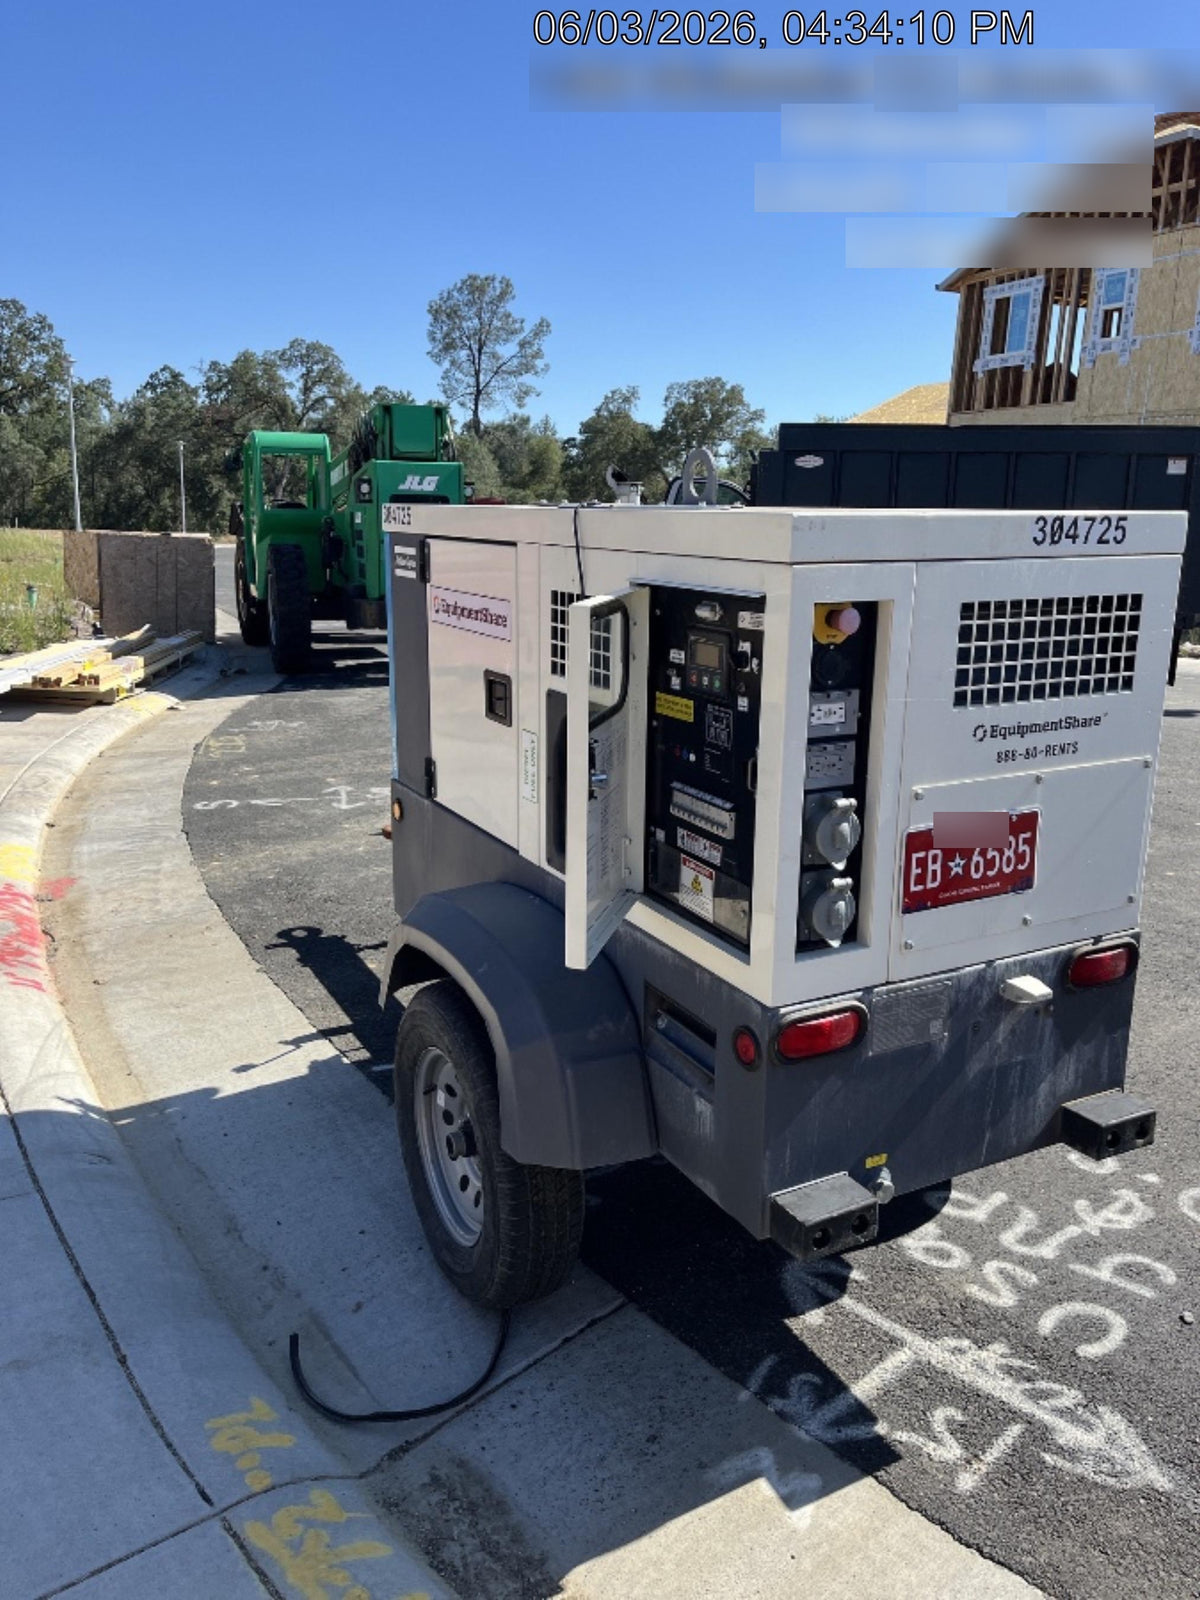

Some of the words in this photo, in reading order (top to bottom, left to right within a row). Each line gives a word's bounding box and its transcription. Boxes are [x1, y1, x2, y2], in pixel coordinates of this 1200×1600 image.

[398, 475, 440, 491] JLG
[1033, 515, 1129, 547] 304725
[989, 714, 1102, 741] EquipmentShare
